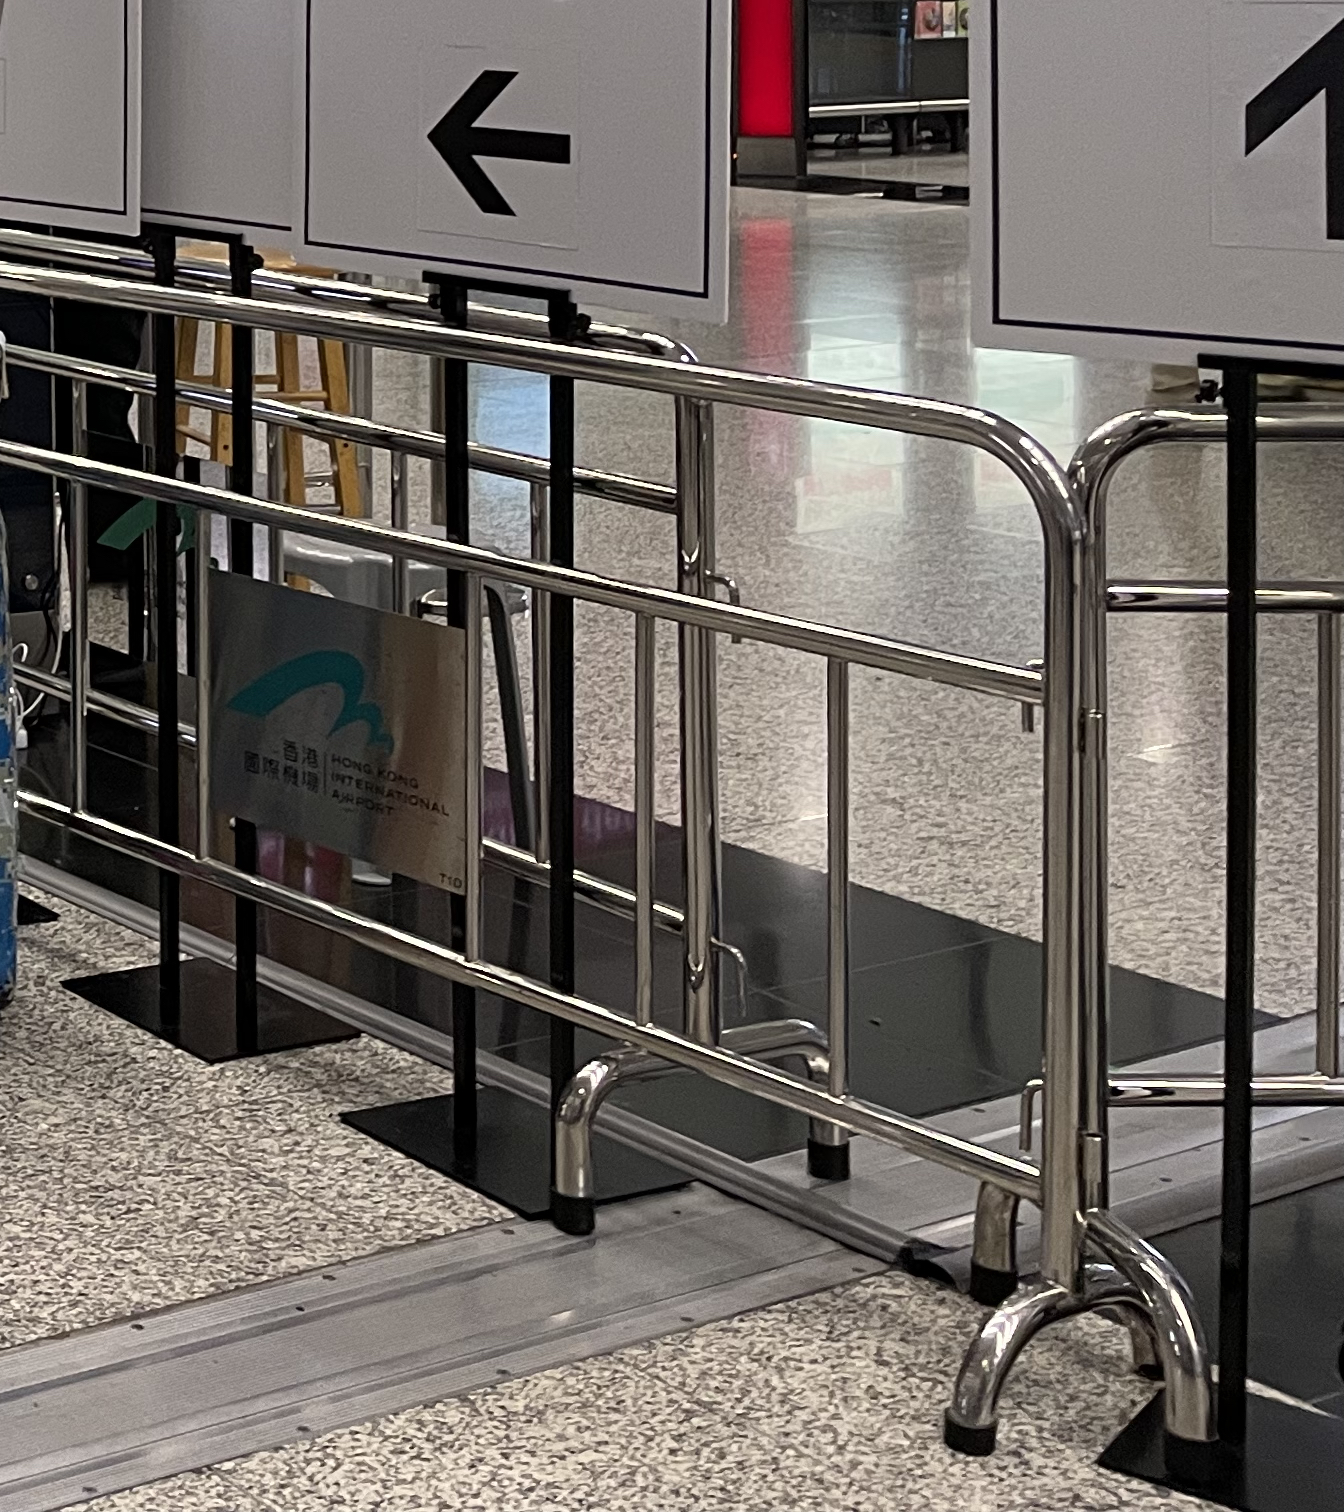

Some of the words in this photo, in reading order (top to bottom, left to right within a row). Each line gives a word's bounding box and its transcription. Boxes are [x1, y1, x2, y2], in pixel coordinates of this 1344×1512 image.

[331, 753, 372, 775] HONG
[377, 767, 419, 789] KONG
[331, 772, 450, 816] INTERNATIONAL
[331, 789, 395, 815] AIRPORT
